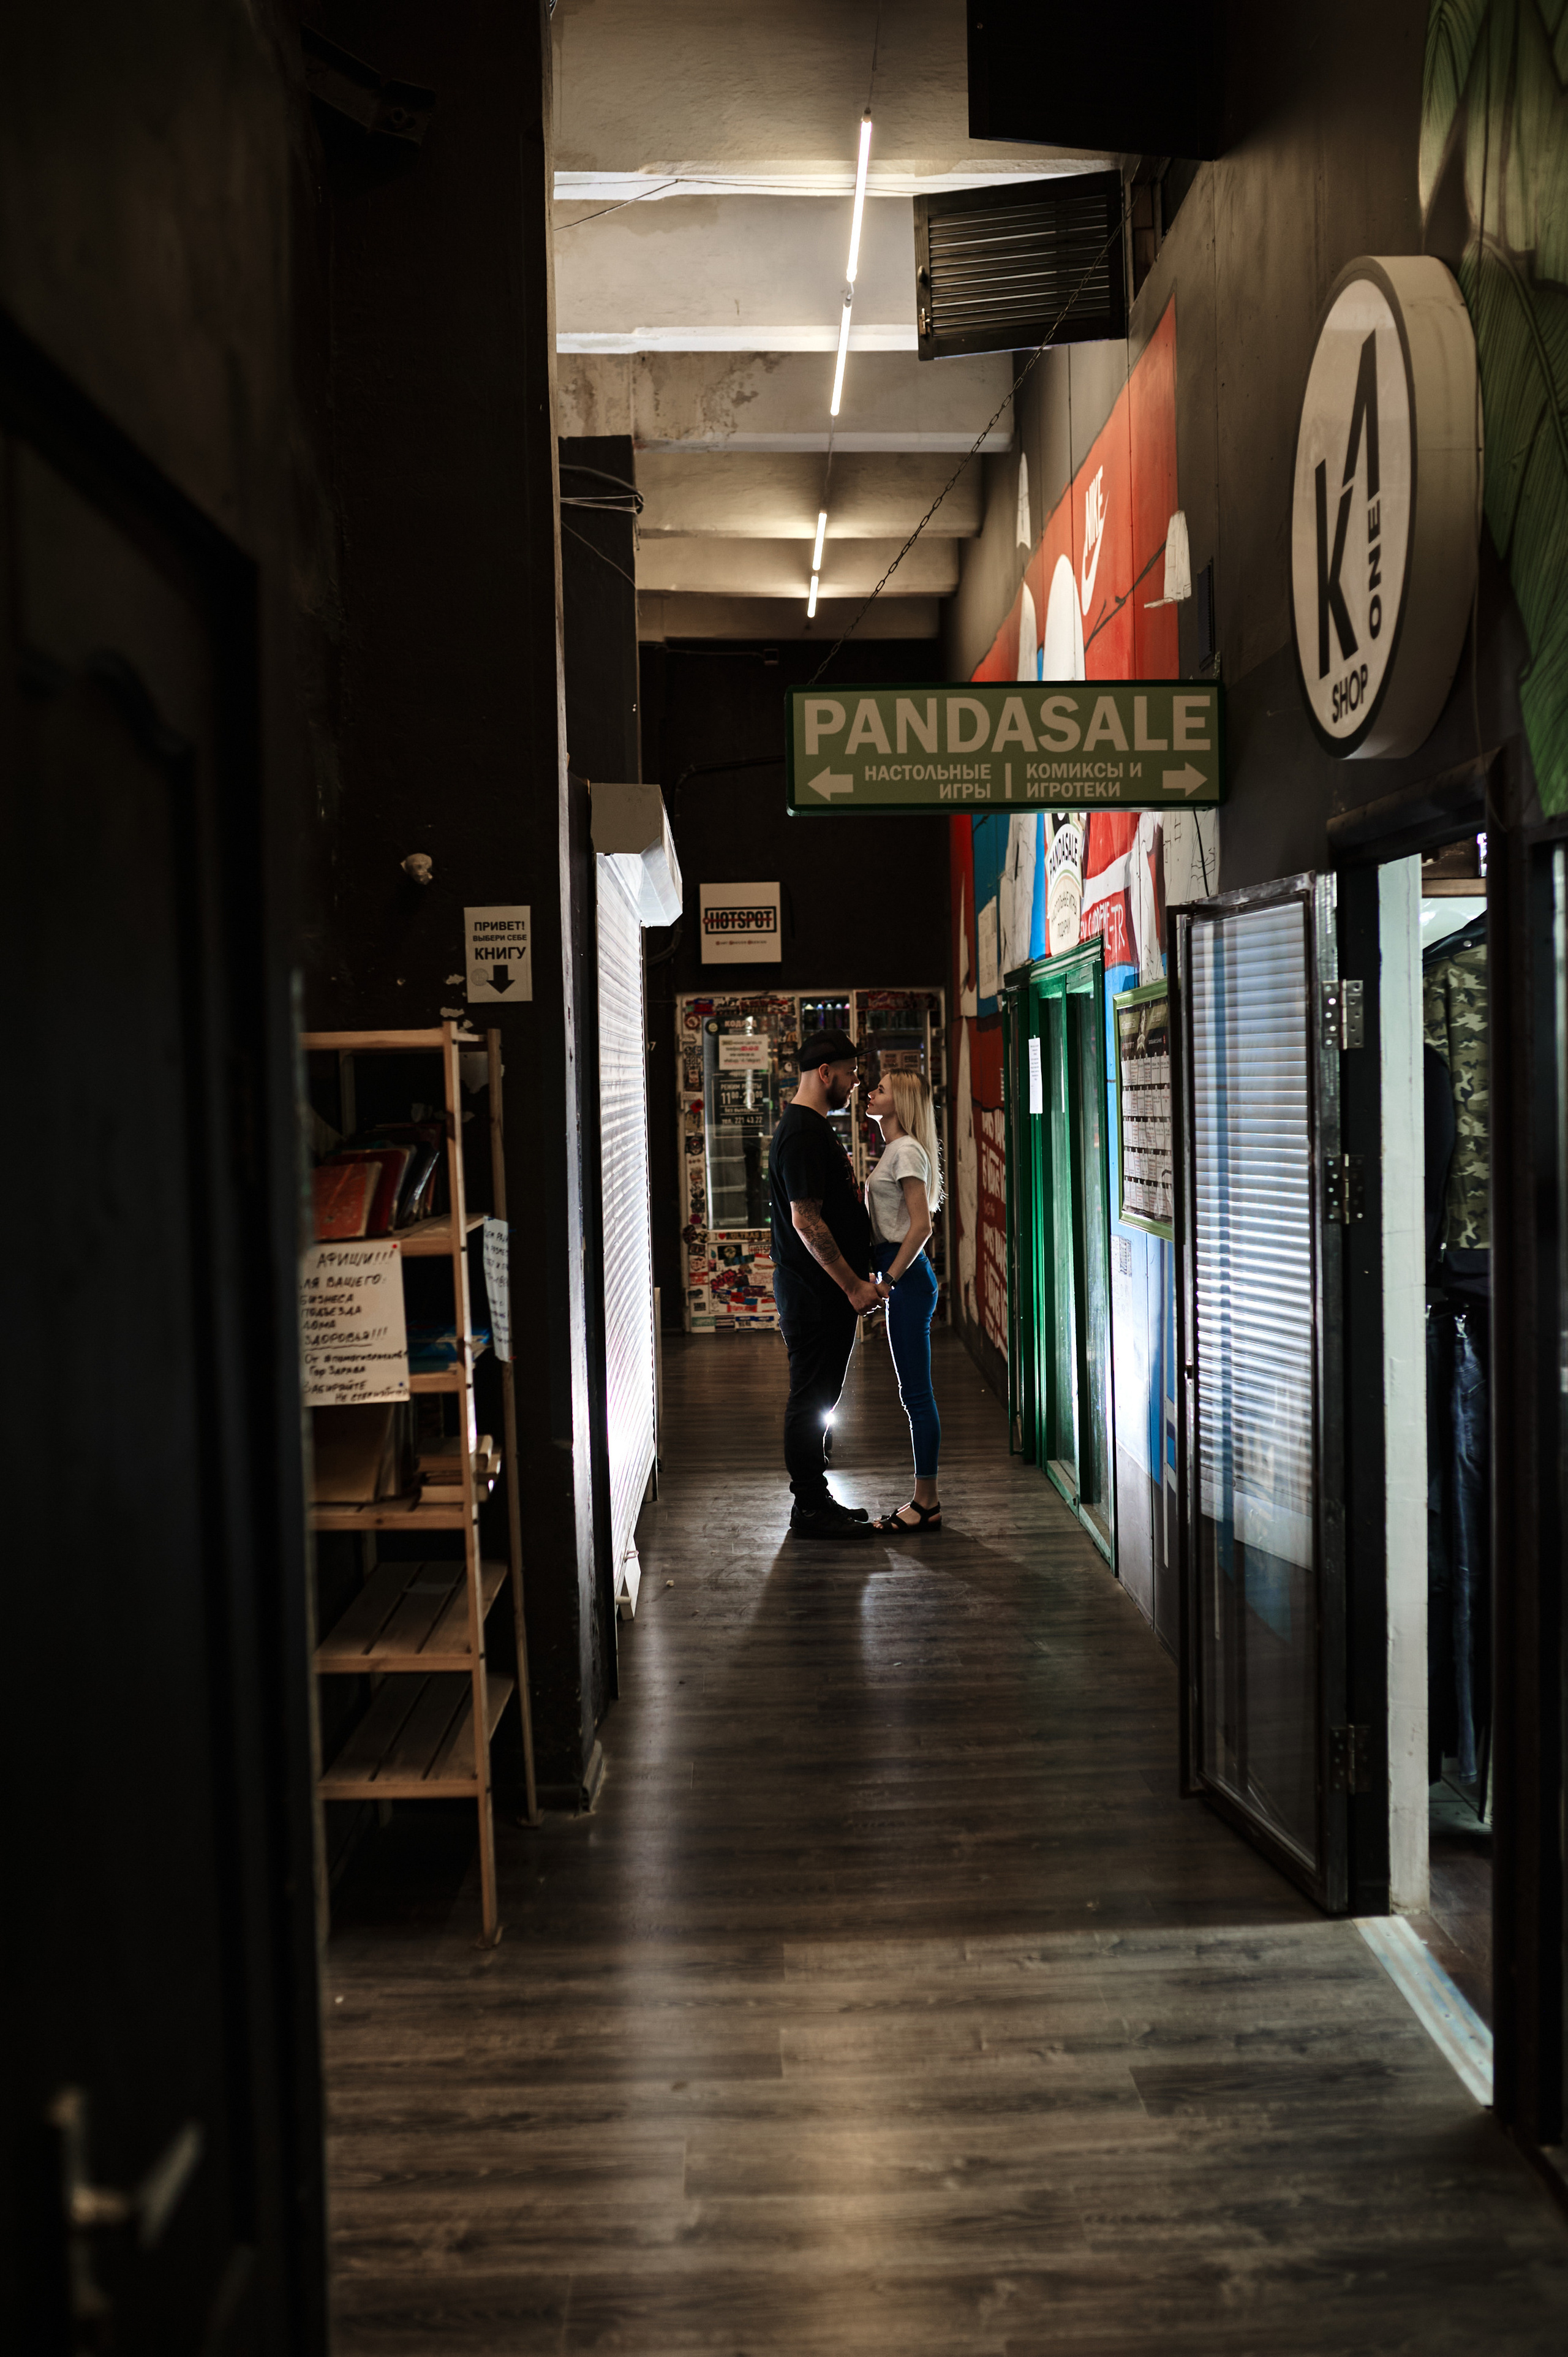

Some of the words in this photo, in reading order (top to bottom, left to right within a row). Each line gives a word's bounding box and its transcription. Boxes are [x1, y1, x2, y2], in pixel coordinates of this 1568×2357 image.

[1085, 464, 1103, 557] NIKE
[1366, 498, 1382, 640] ONE
[1332, 663, 1369, 725] SHOP
[804, 695, 1212, 755] PANDASALE
[864, 763, 992, 782] НАСТОЛЬНЫЕ
[1026, 762, 1124, 779] КОМИКСЫ
[1129, 762, 1142, 778] И
[939, 782, 991, 800] ИГРЫ
[1027, 781, 1121, 798] ИГРОТЕКИ
[1049, 831, 1079, 885] PANDASALE
[474, 921, 526, 931] ПРИВЕТ!
[710, 910, 772, 929] HOTSPOT
[474, 947, 527, 960] КНИГУ
[300, 1293, 355, 1306] БИЗНЕСА
